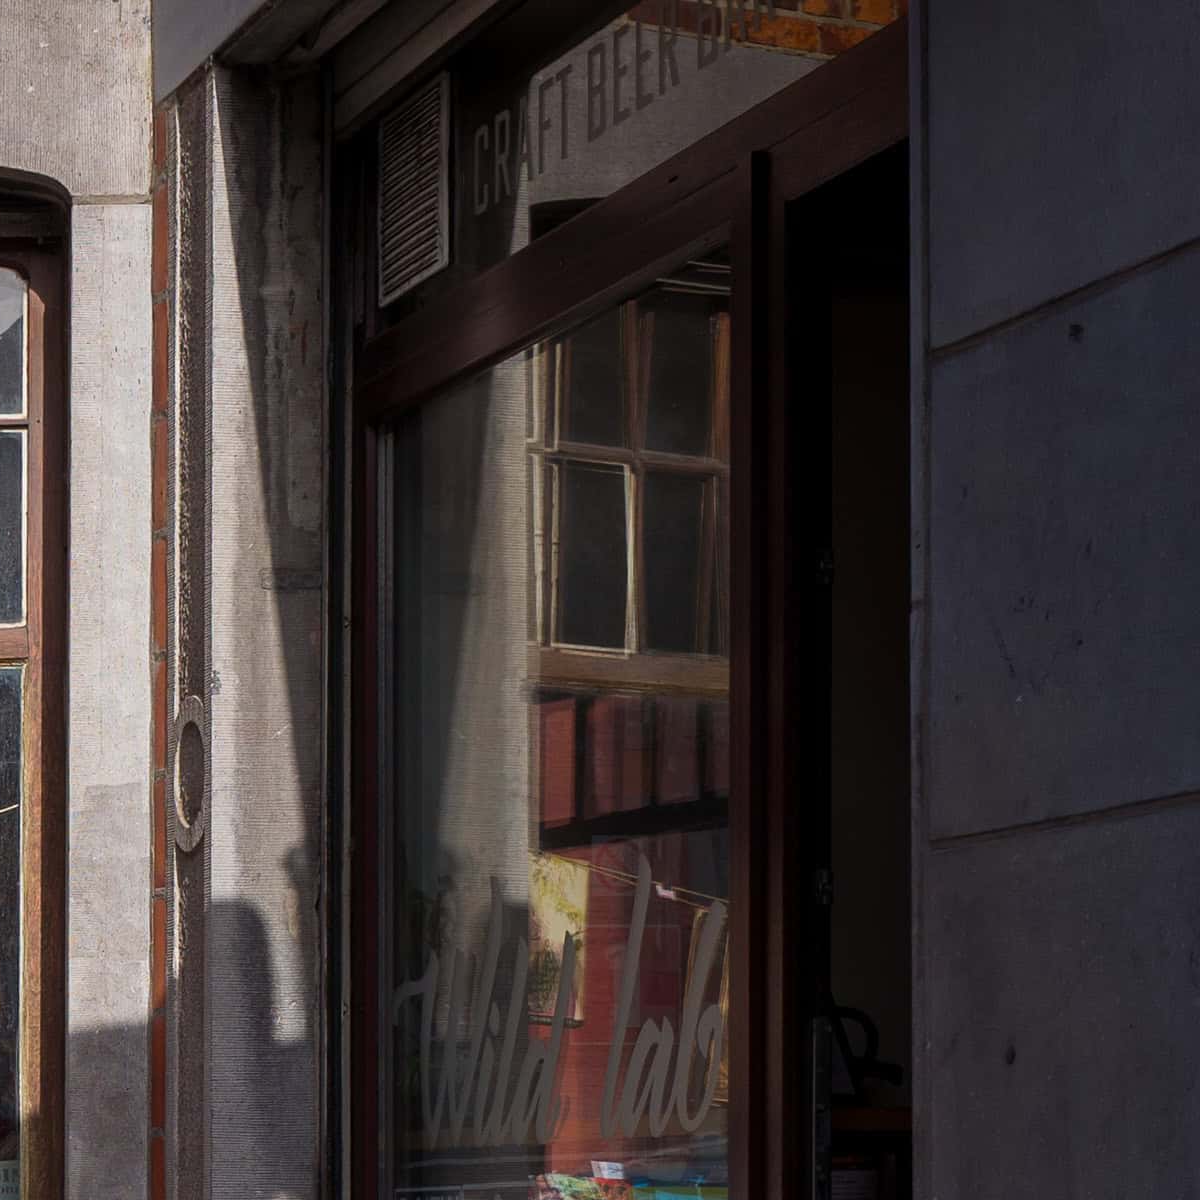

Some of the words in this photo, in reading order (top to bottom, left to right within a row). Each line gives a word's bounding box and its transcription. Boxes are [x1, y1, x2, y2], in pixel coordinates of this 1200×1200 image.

[474, 64, 572, 216] CRAFT
[587, 0, 680, 144] BEER
[601, 853, 727, 1139] lab
